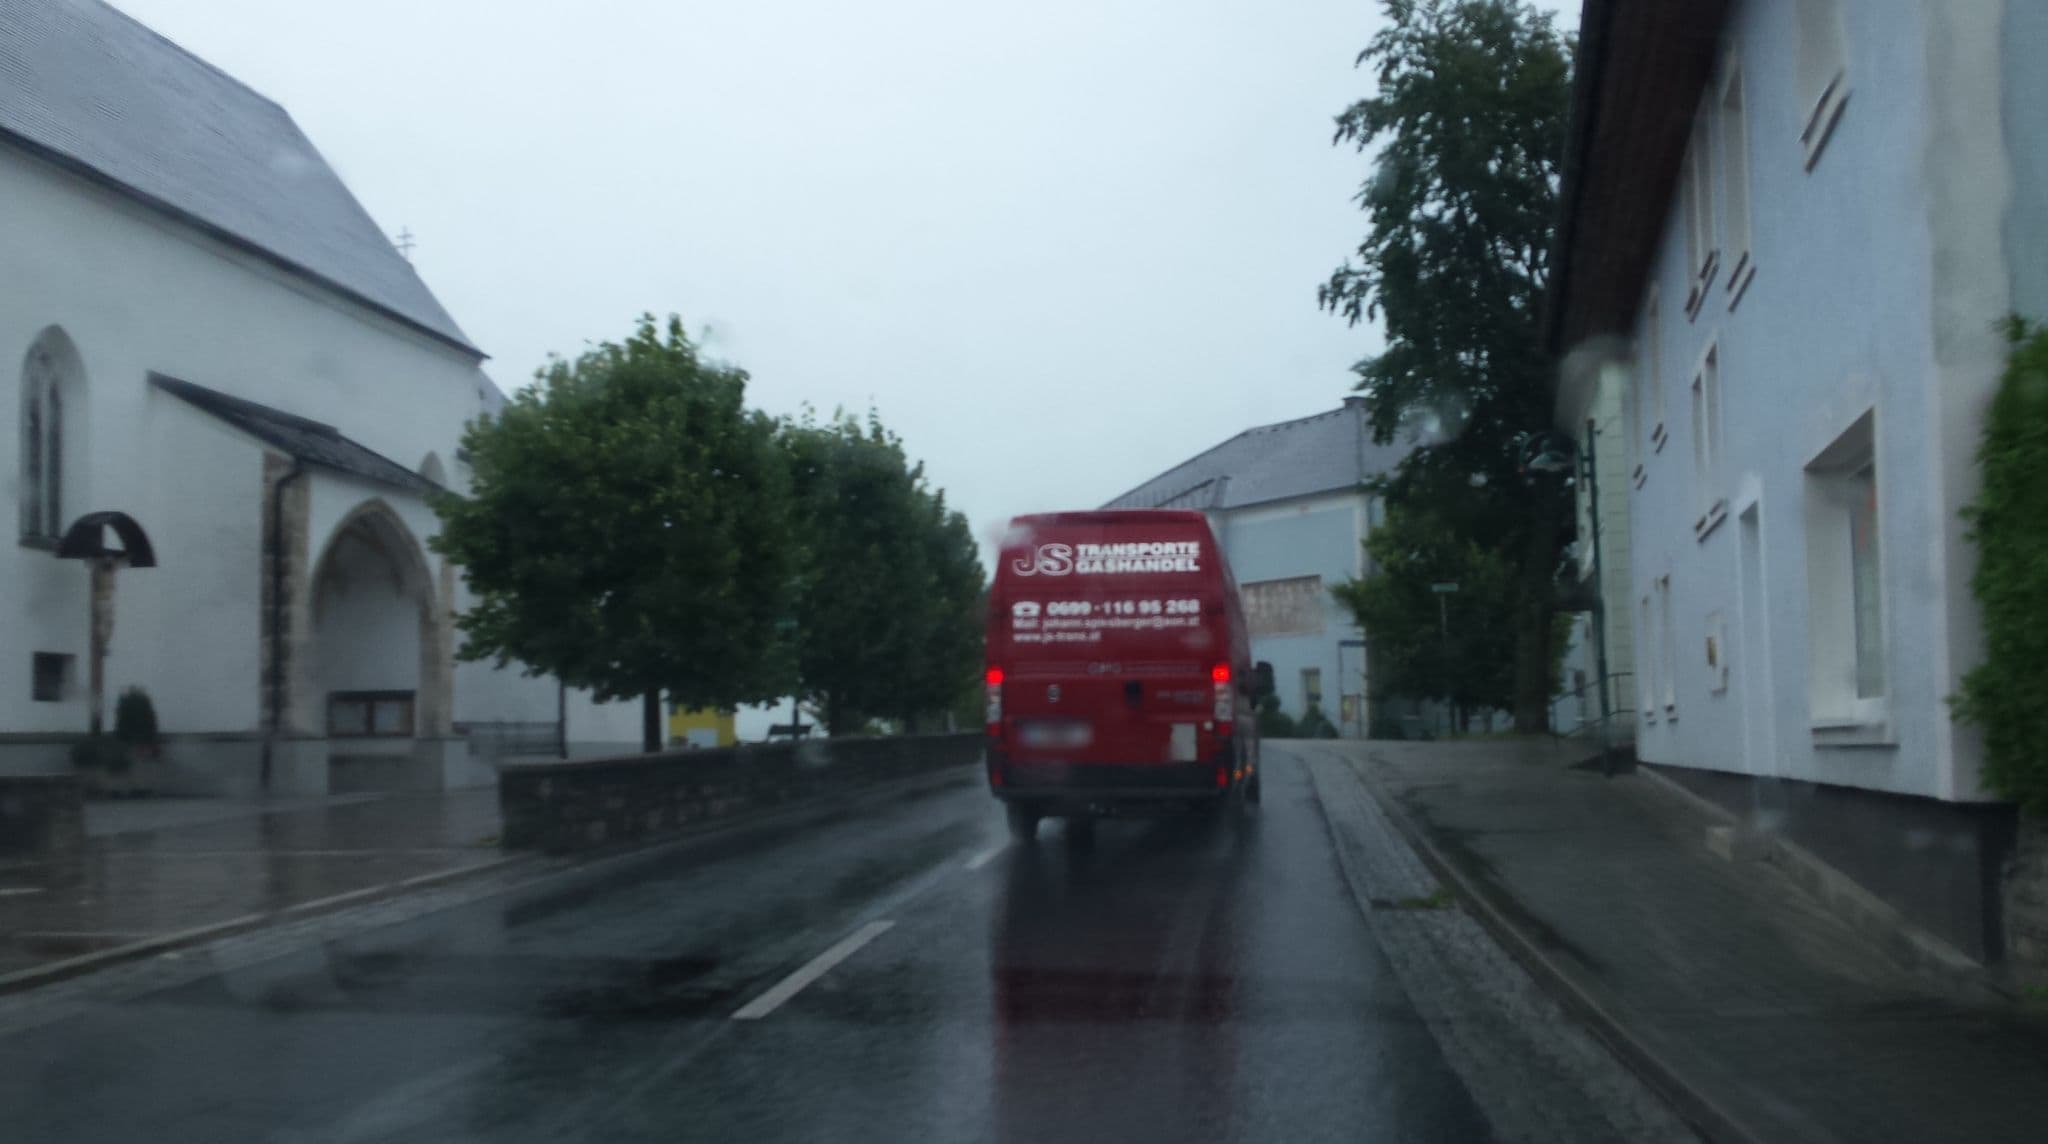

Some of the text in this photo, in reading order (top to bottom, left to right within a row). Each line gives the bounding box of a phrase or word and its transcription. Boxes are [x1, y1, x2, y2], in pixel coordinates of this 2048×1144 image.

[1076, 541, 1200, 556] TRANSPORTE
[1012, 543, 1073, 576] JS
[1076, 557, 1200, 574] GASHANDEL
[1046, 601, 1092, 616] 0699
[1103, 600, 1136, 615] 116
[1138, 600, 1162, 614] 95
[1165, 599, 1200, 614] 268
